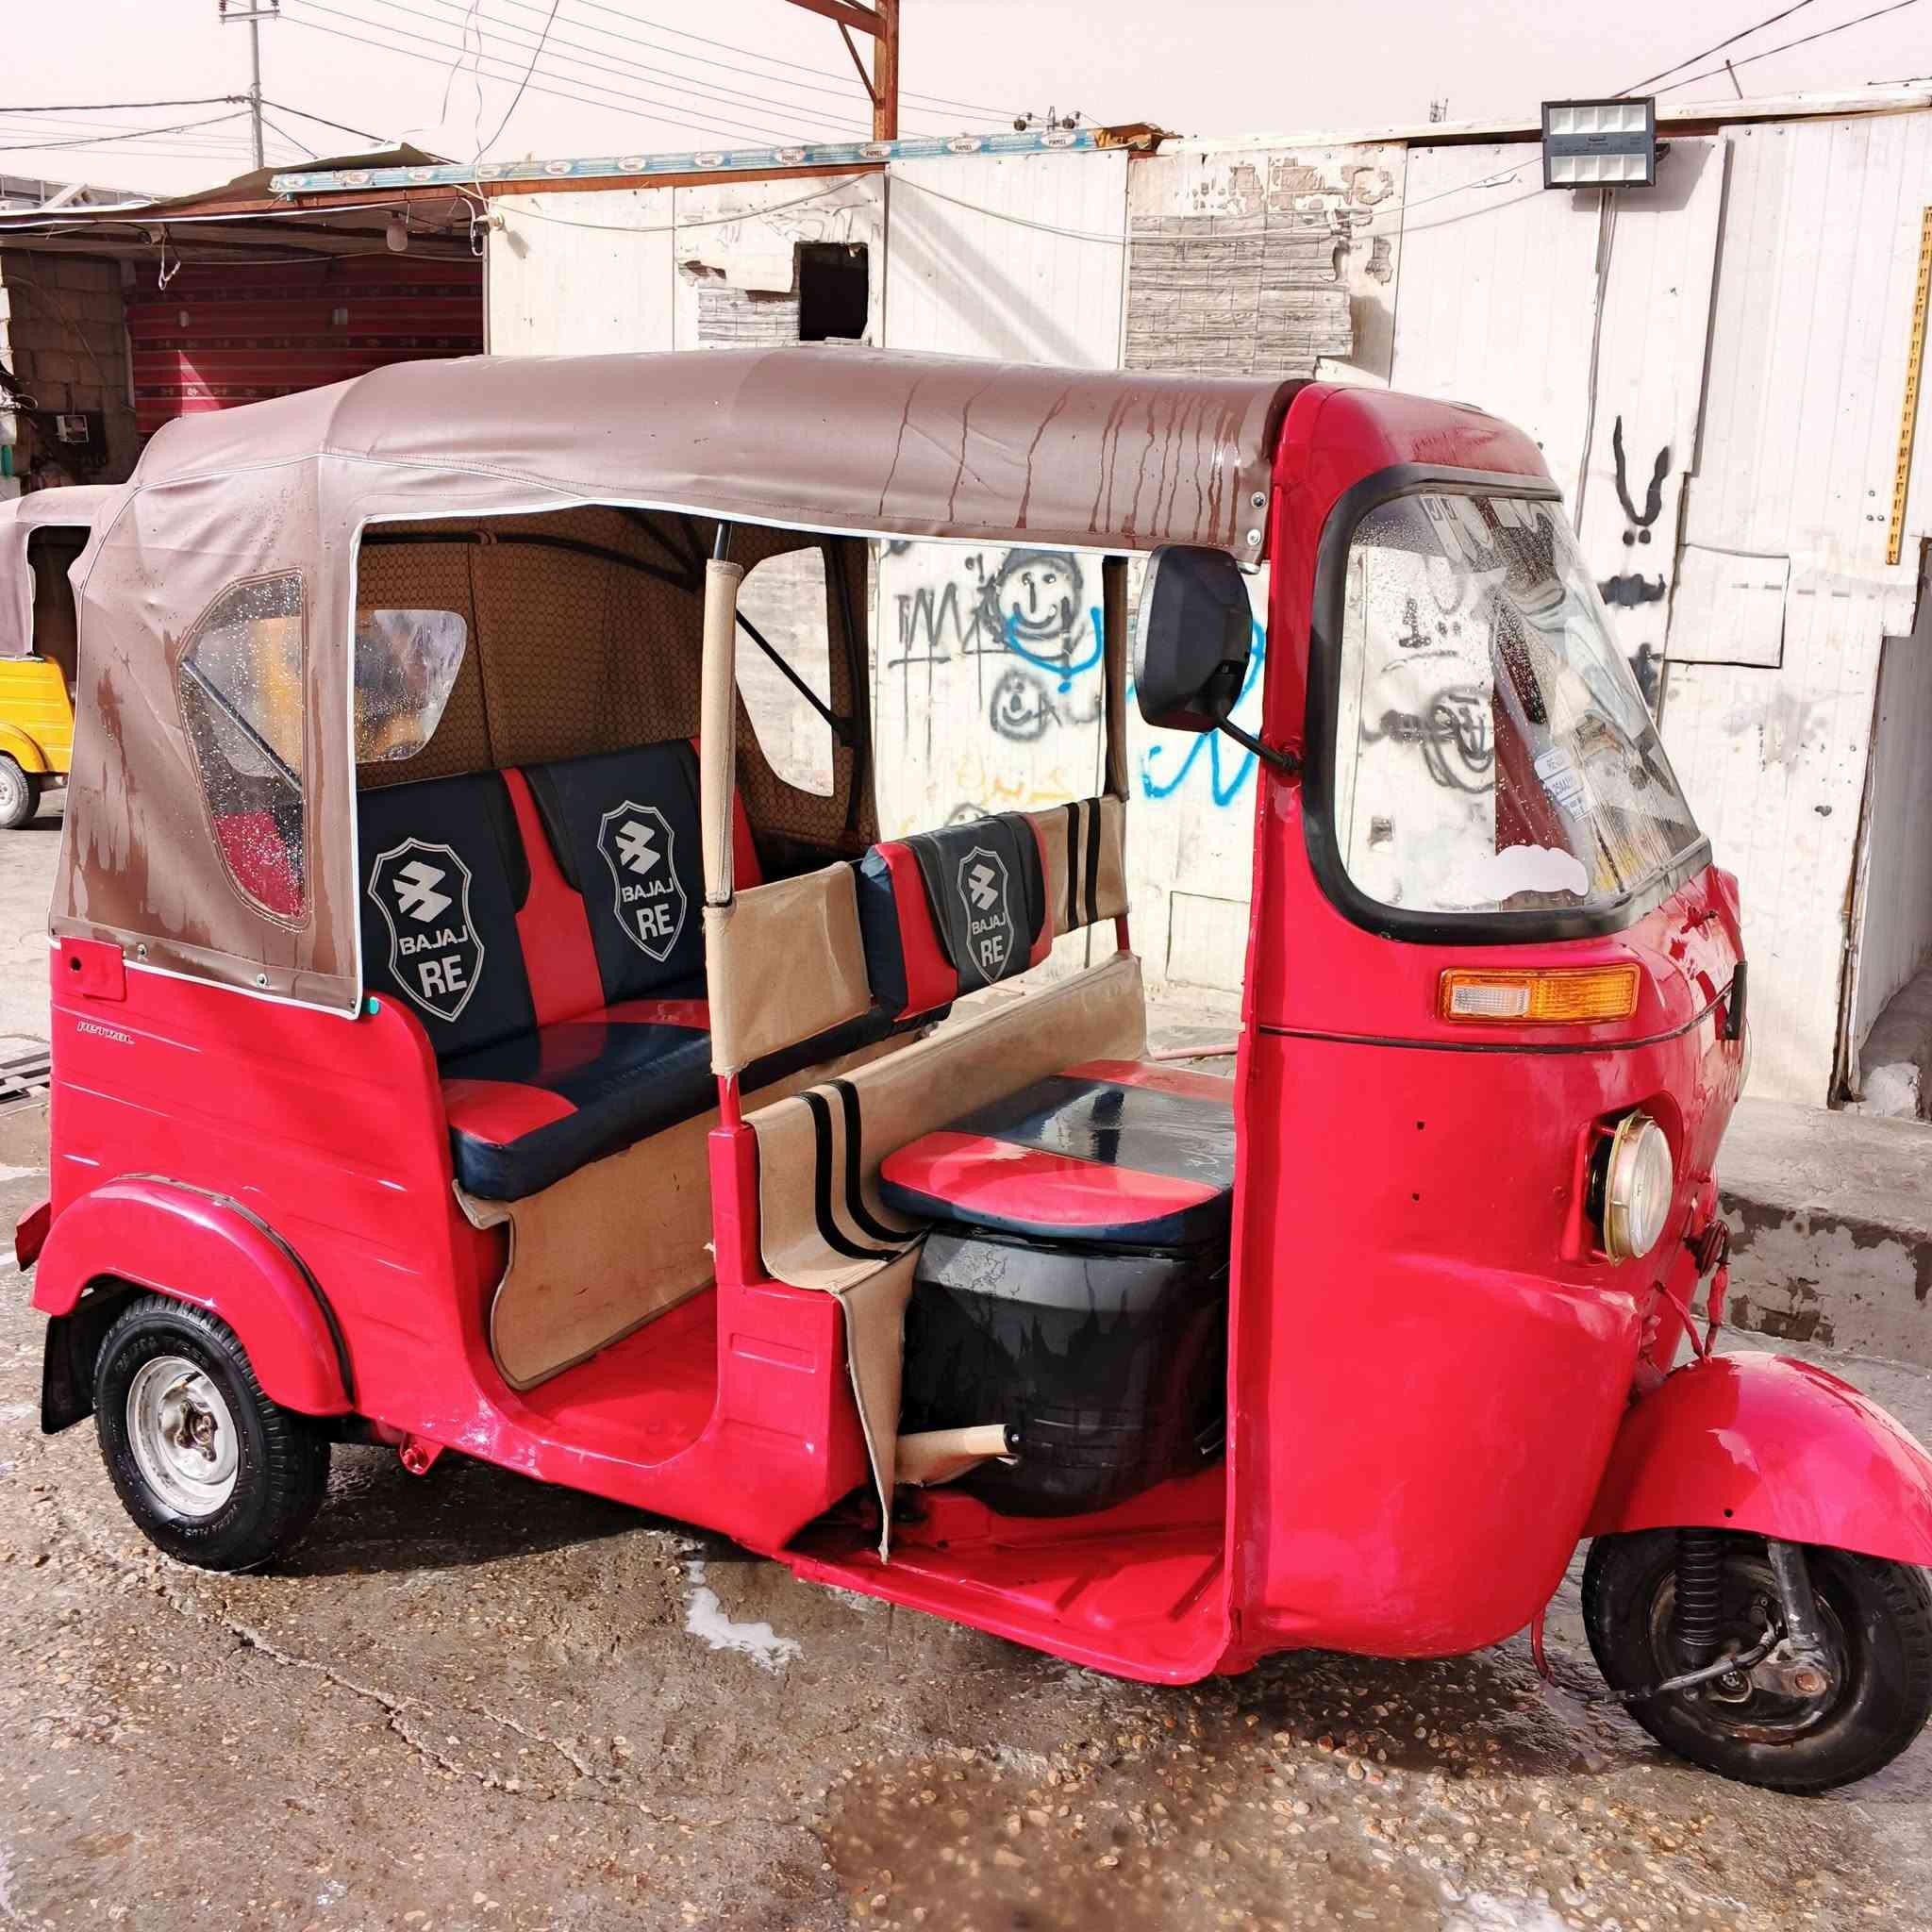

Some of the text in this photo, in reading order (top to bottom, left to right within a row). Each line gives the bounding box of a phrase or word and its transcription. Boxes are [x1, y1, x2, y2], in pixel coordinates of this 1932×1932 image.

[622, 877, 675, 903] BAJAJ
[635, 903, 675, 941] RE
[972, 912, 1007, 936] BAJAJ
[398, 924, 469, 956] BAJAJ
[980, 935, 1005, 967] RE
[418, 954, 468, 998] RE
